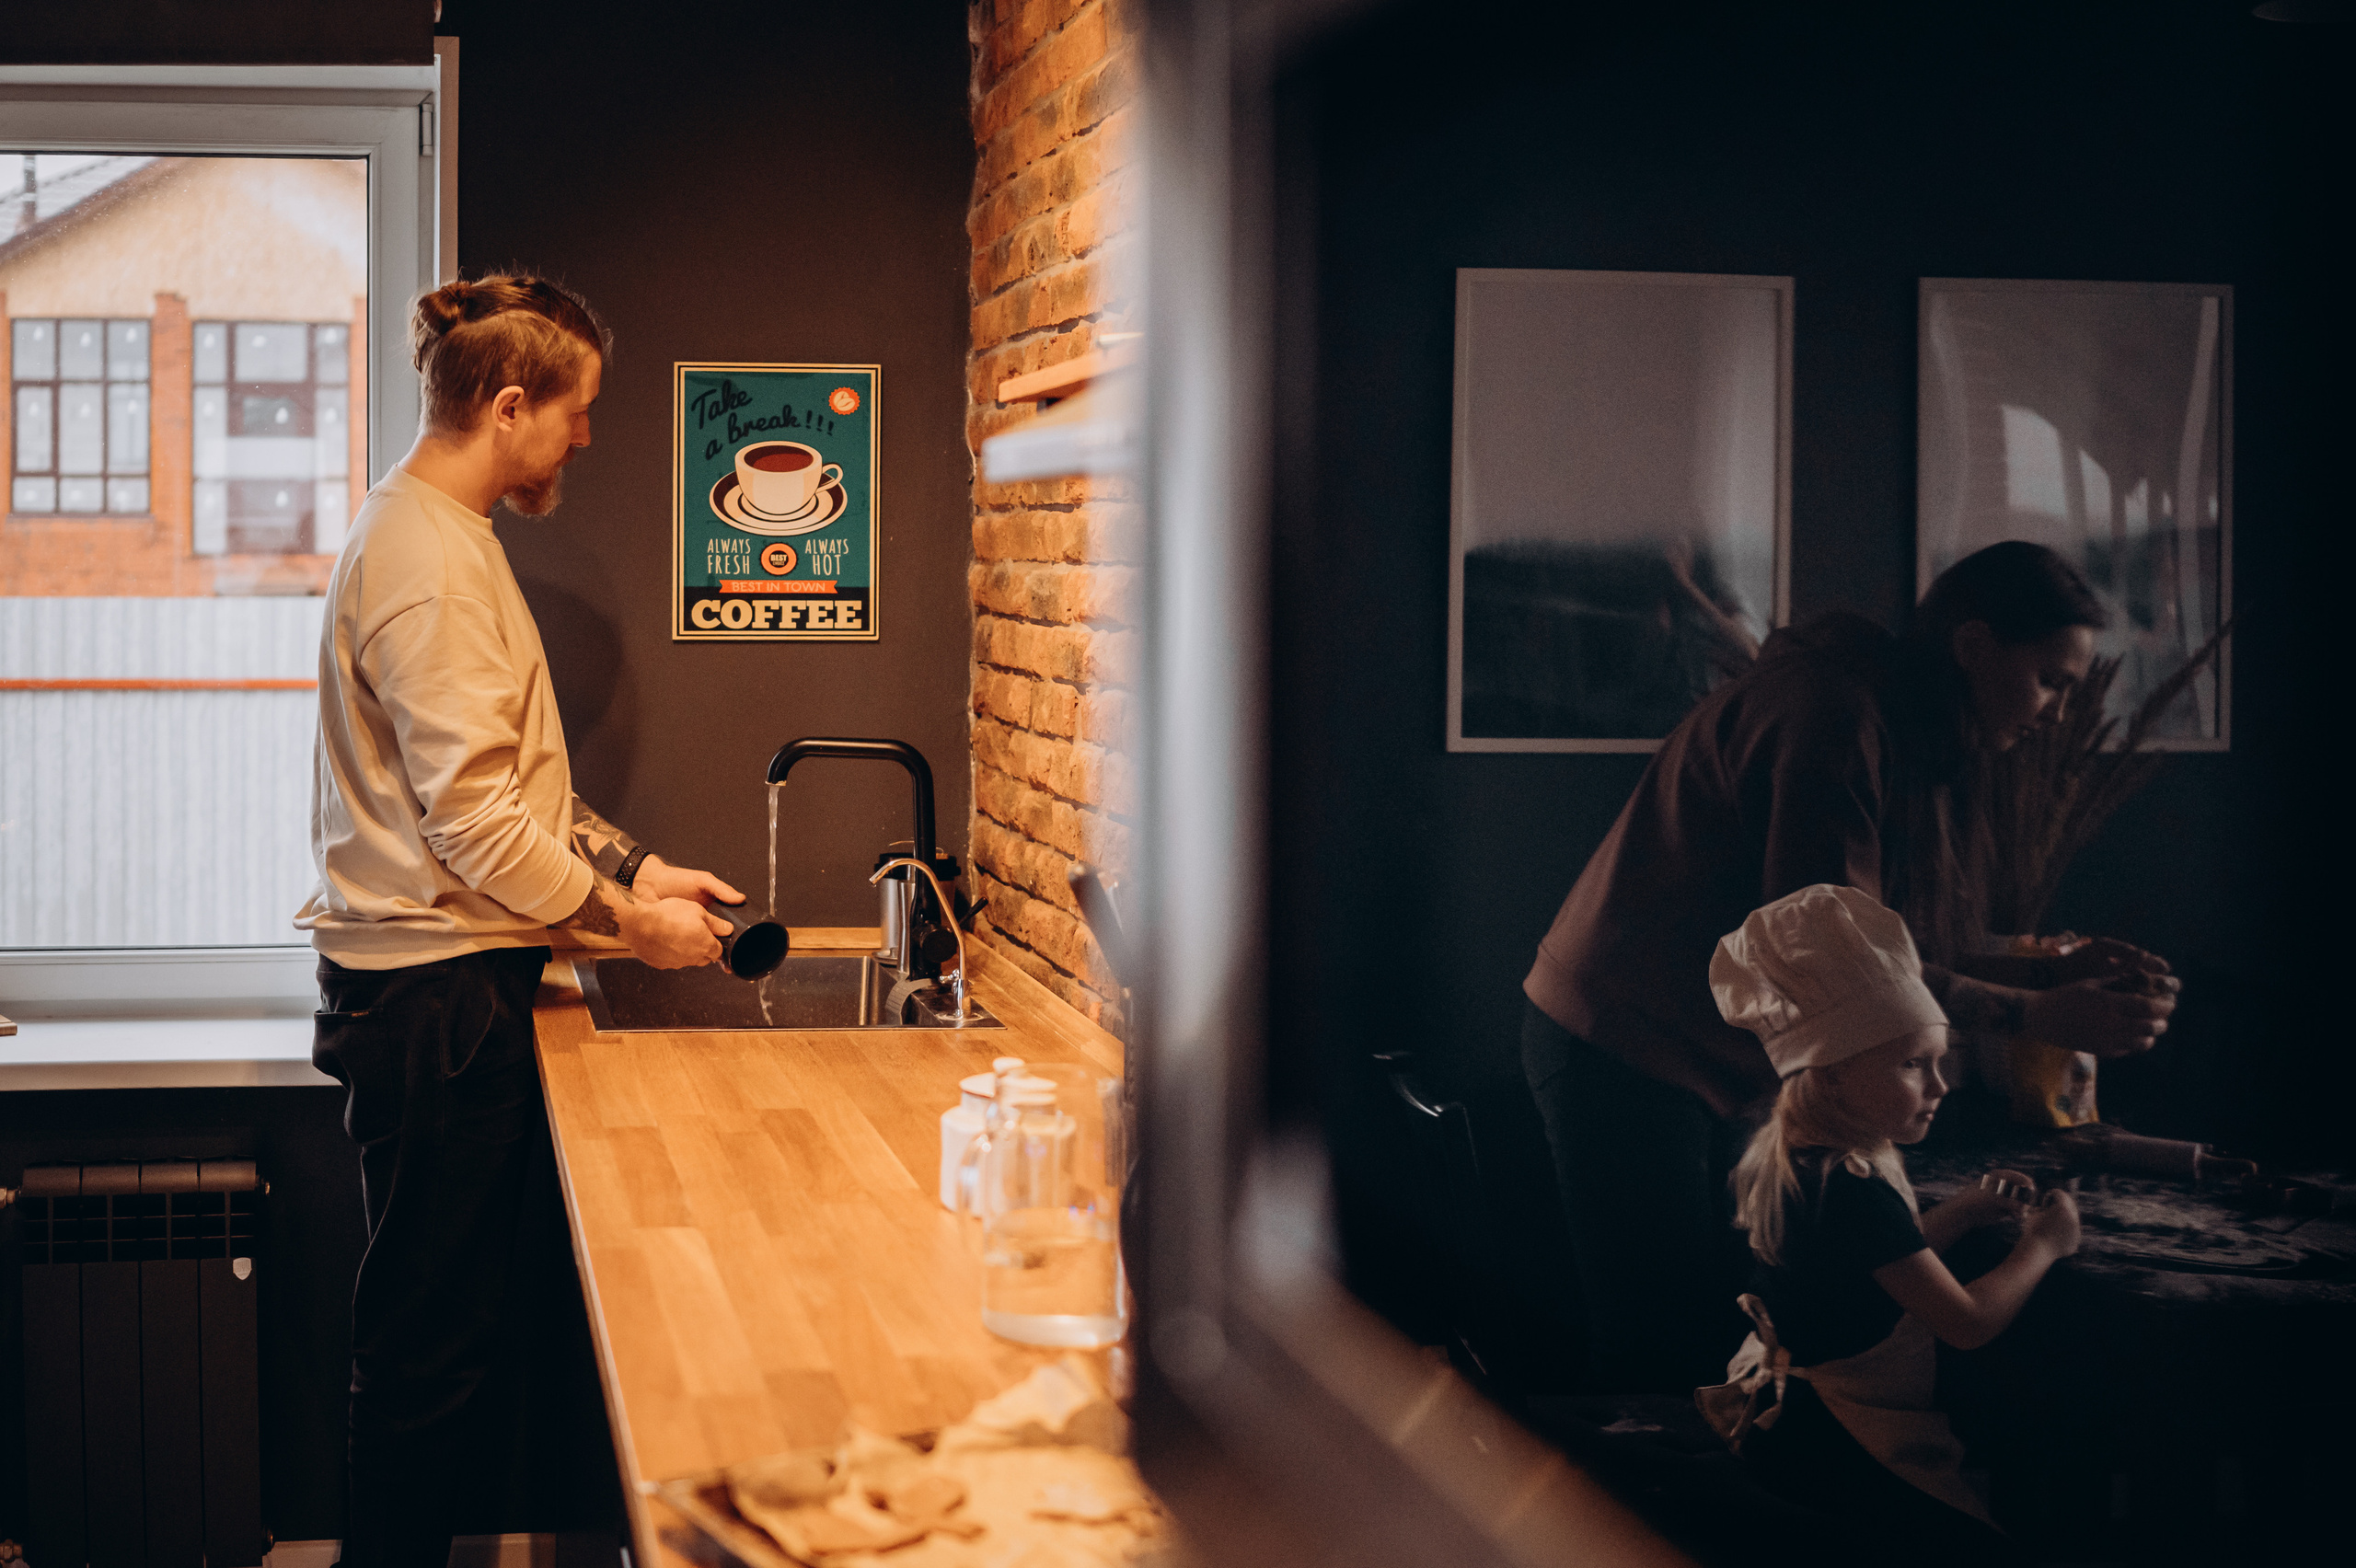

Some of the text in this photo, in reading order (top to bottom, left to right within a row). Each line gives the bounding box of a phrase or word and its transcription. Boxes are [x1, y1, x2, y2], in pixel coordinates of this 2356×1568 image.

[691, 379, 753, 430] Take
[705, 439, 723, 460] a
[707, 538, 751, 554] ALWAYS
[804, 539, 849, 555] ALWAYS
[707, 555, 750, 575] FRESH
[770, 554, 788, 562] BEST
[812, 555, 841, 576] HOT
[732, 582, 826, 592] BEST IN TOWN
[691, 599, 862, 629] COFFEE
